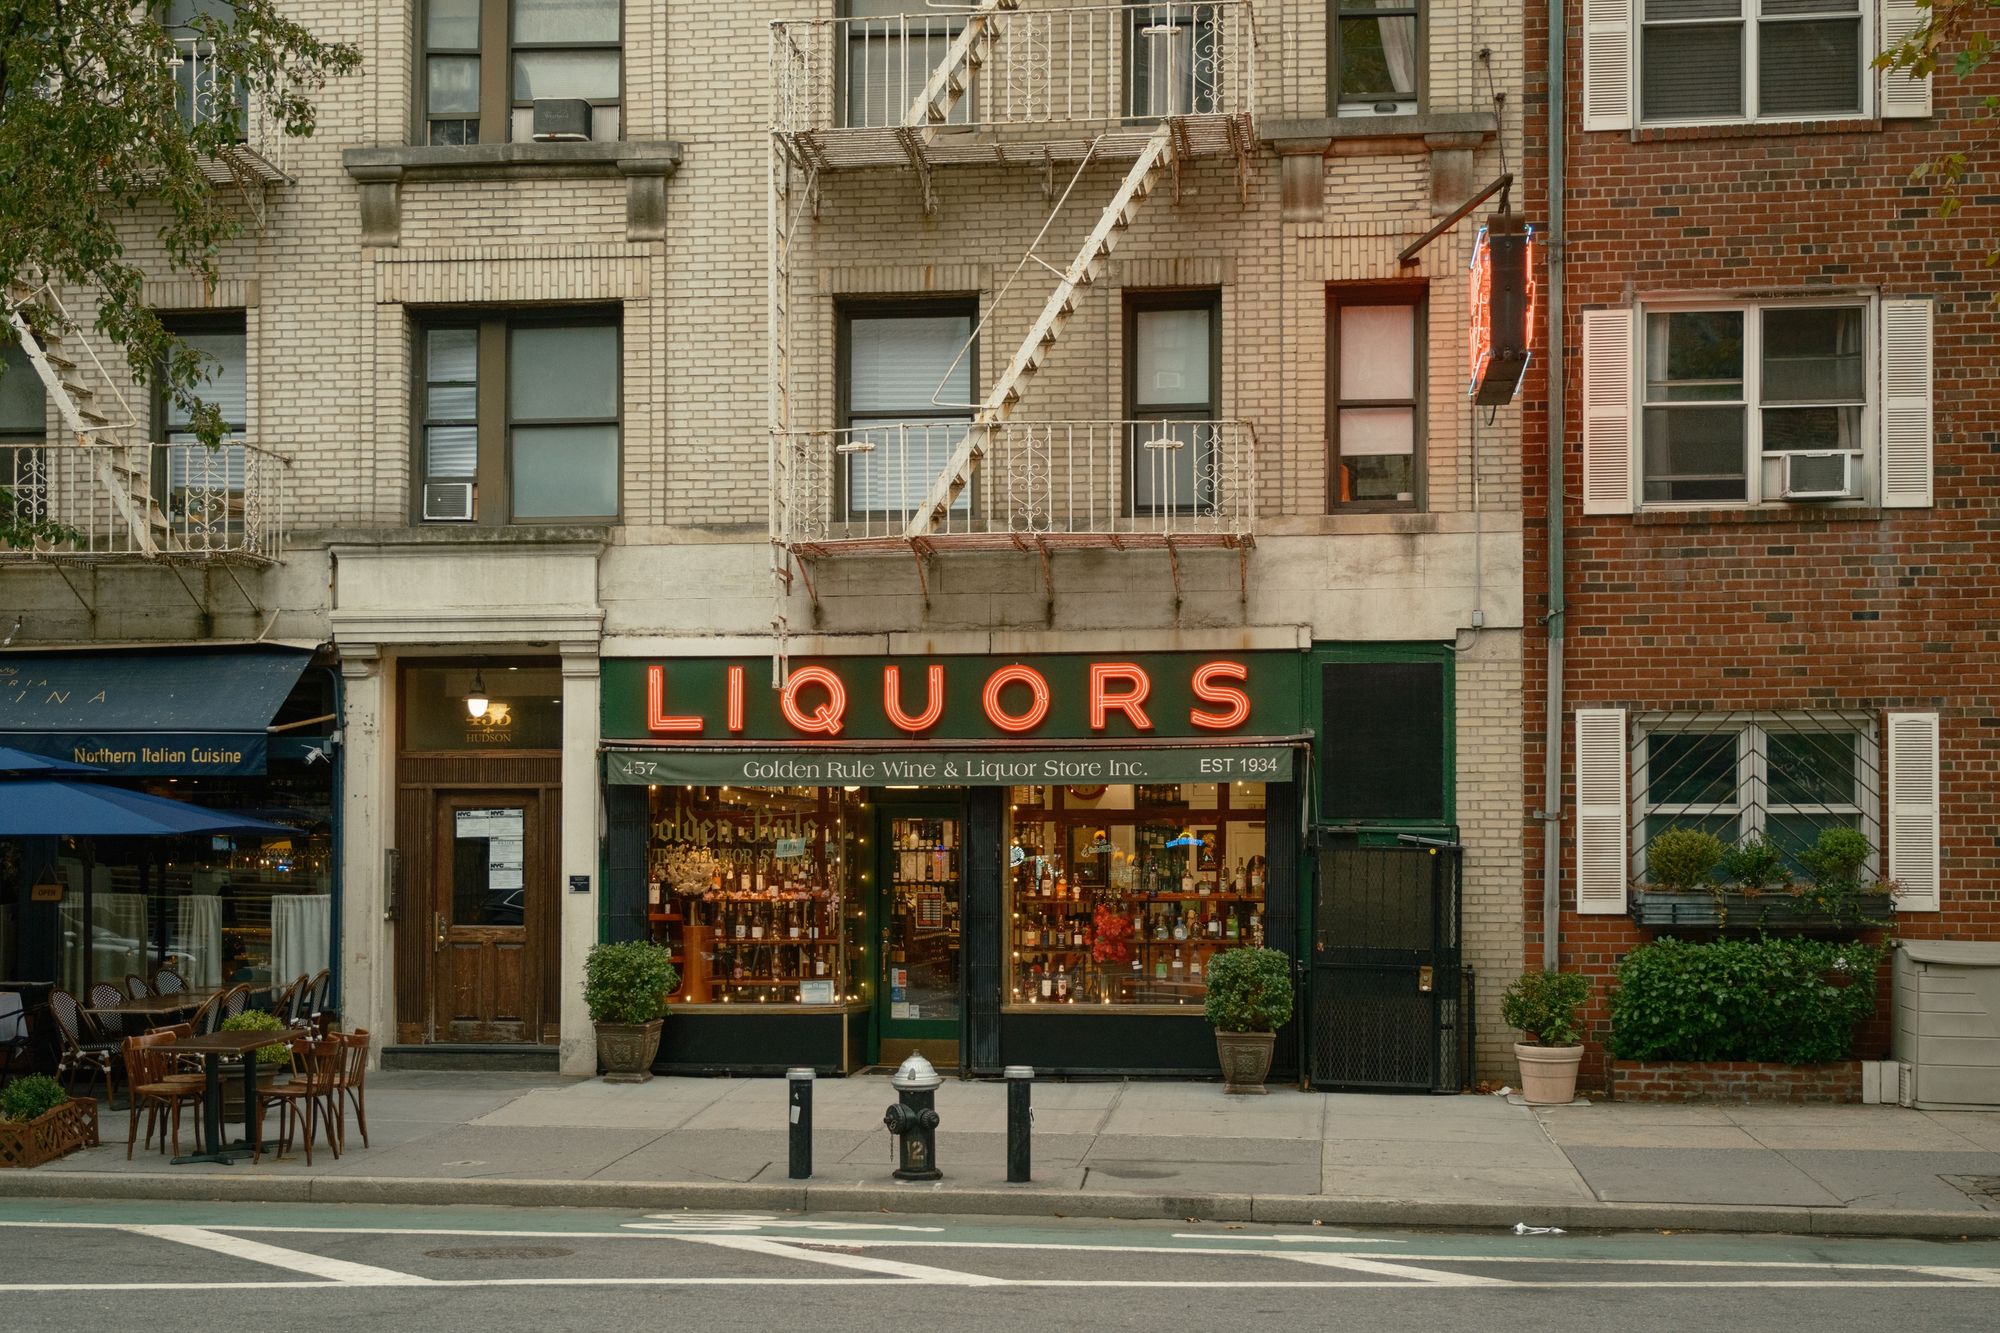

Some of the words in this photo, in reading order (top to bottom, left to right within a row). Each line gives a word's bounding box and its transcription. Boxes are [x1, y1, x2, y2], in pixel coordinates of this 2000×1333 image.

[648, 661, 1251, 735] LIQUORS
[467, 733, 511, 743] HUDSON
[74, 748, 136, 763] Northern
[142, 748, 186, 763] Italian
[191, 748, 242, 763] Cuisine
[622, 761, 658, 775] 457
[743, 761, 820, 779] Golden
[827, 761, 876, 778] Rule
[881, 761, 935, 778] Wine
[943, 761, 959, 778] &
[966, 759, 1038, 781] Liquor
[1043, 758, 1102, 777] Store
[1109, 758, 1149, 776] Inc.
[1200, 758, 1235, 773] EST
[1240, 757, 1278, 772] 1934
